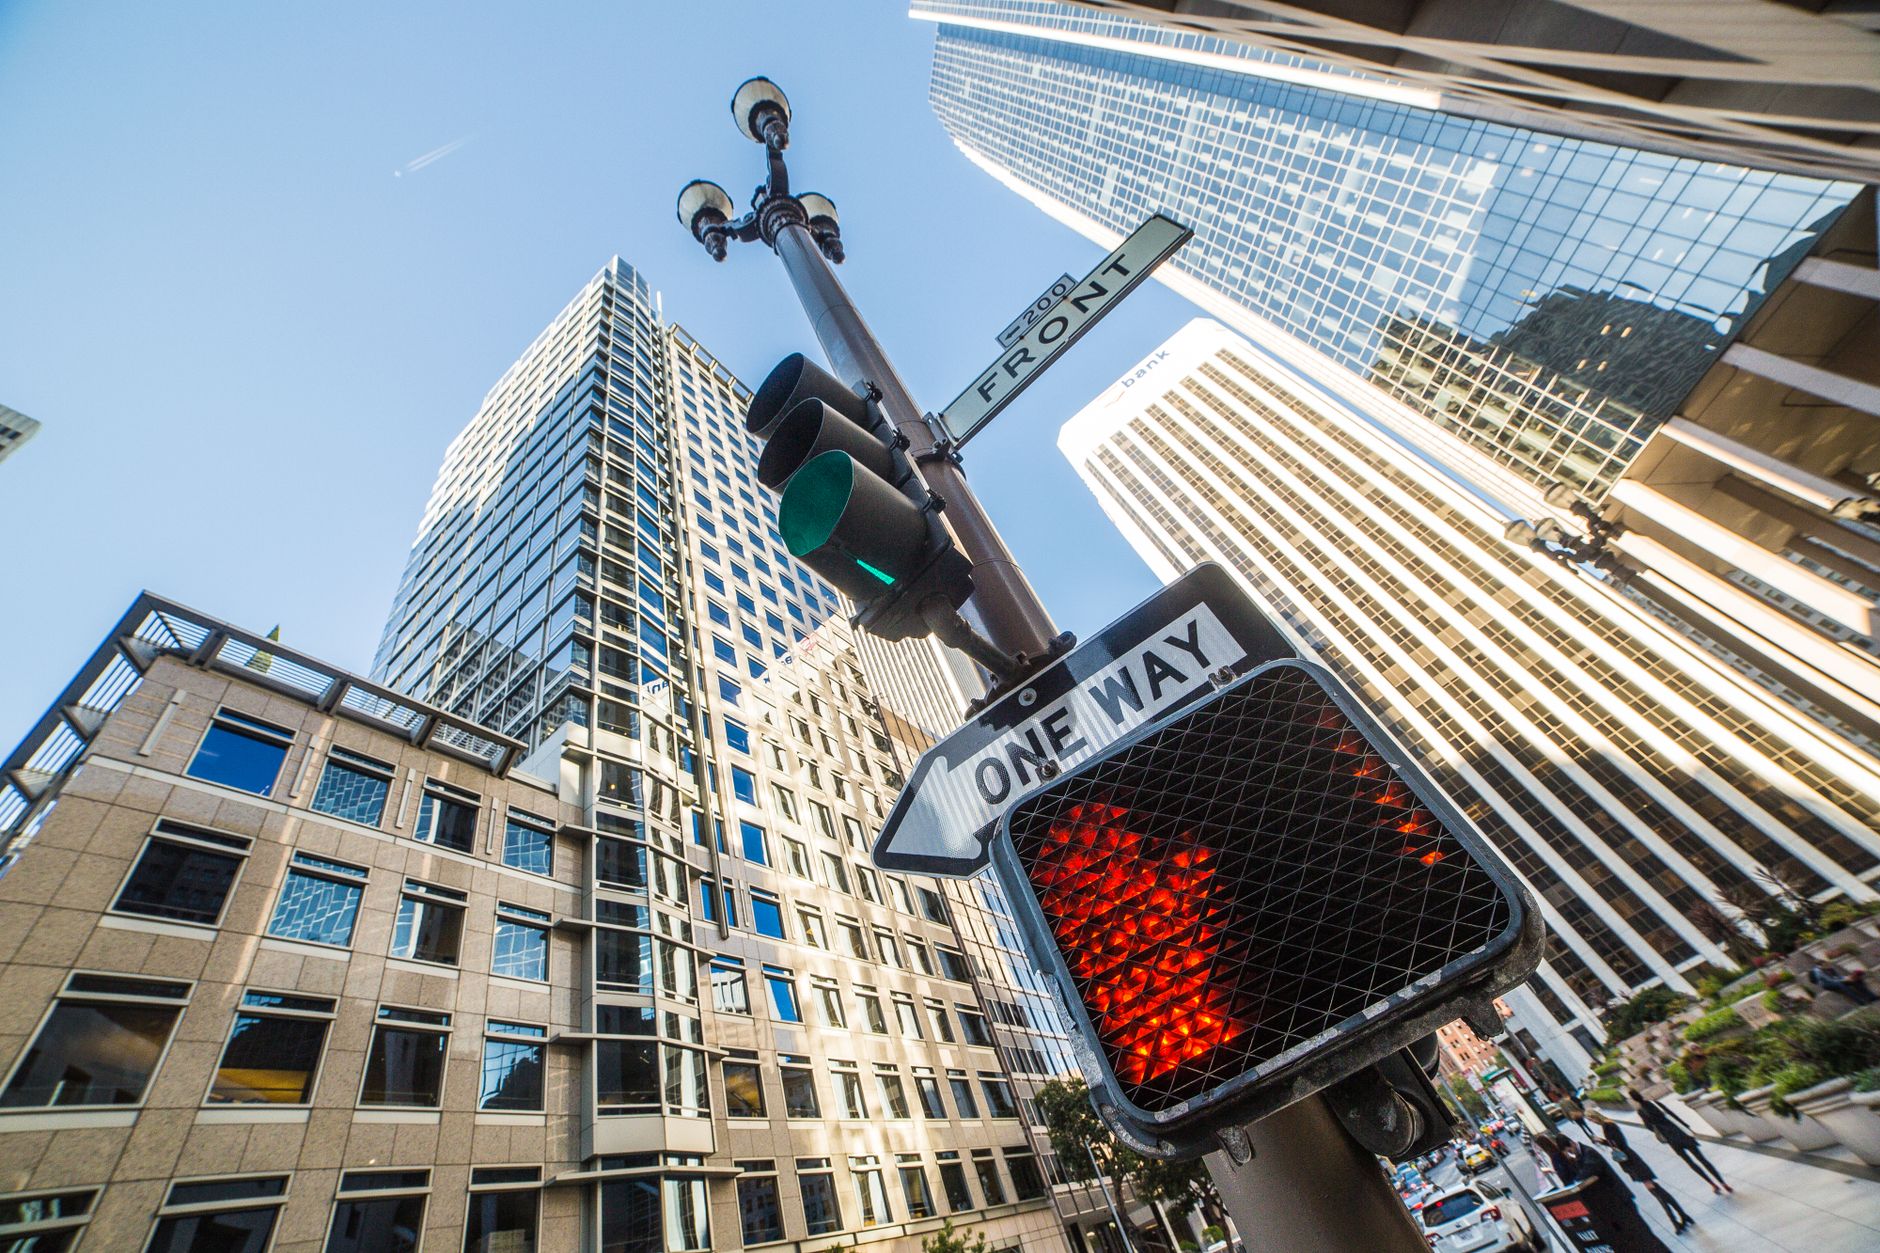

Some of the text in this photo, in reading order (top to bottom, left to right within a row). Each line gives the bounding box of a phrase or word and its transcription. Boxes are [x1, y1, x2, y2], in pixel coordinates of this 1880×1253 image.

[977, 253, 1130, 403] FRONT
[1022, 282, 1067, 326] 200
[1121, 350, 1170, 388] bank
[975, 619, 1211, 805] ONE WAY
